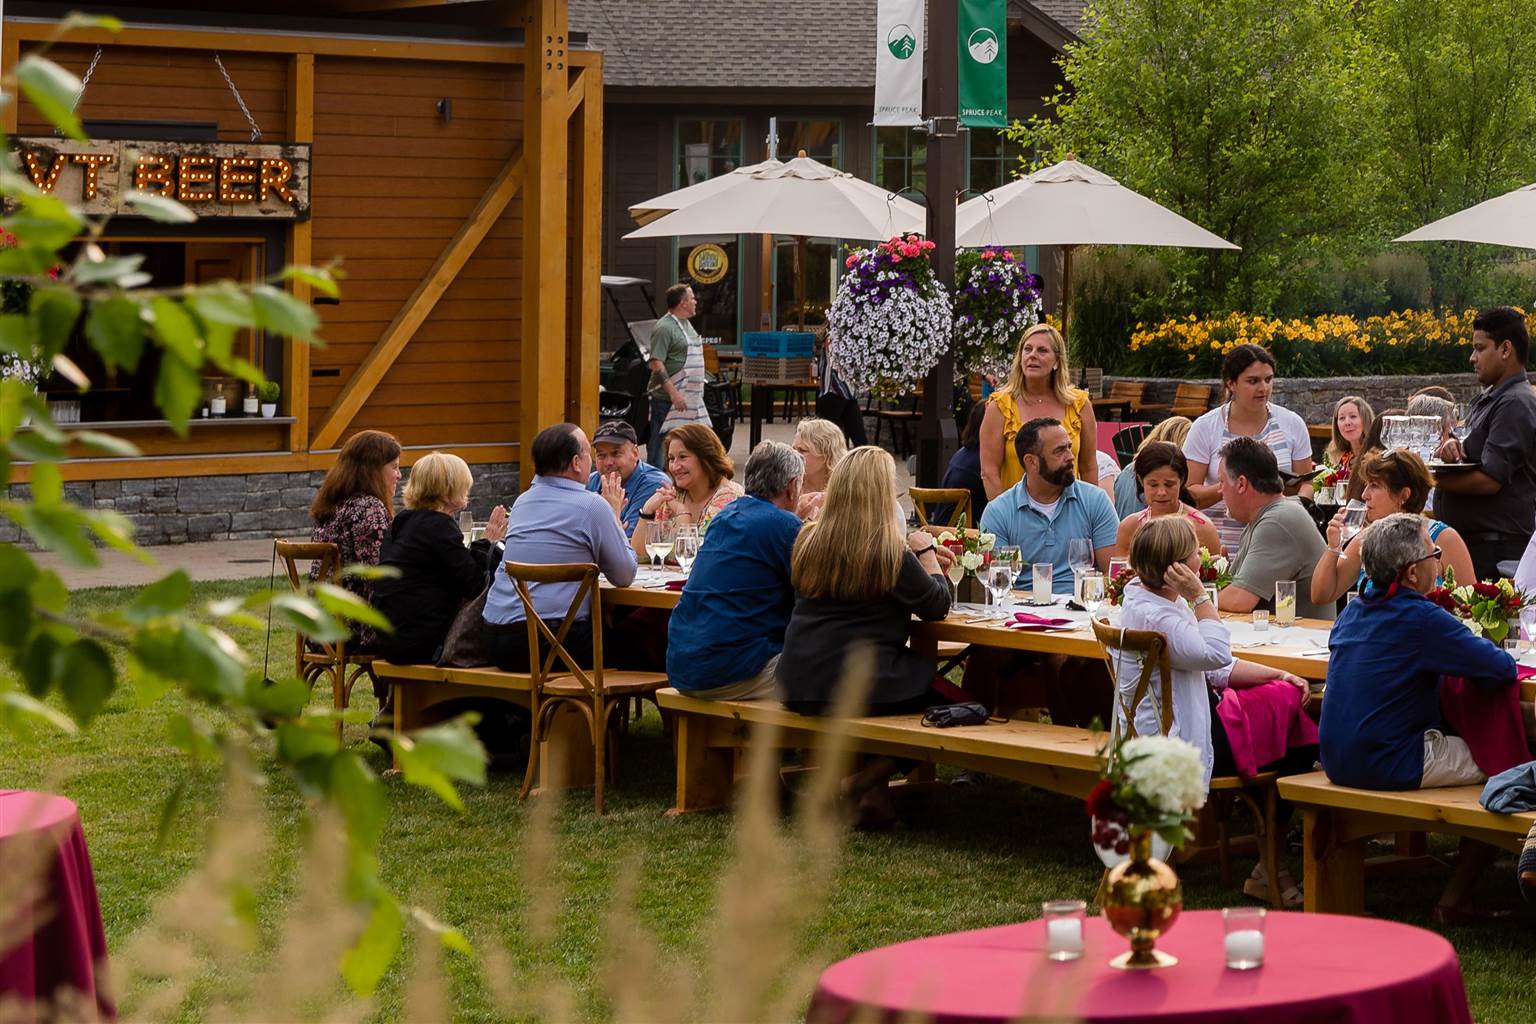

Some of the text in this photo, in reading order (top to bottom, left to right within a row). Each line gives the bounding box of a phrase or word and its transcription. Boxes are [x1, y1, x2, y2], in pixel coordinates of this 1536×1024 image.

[879, 105, 918, 114] SPRUCE PEAK
[962, 108, 1003, 117] SPRUCE PEAK
[20, 149, 297, 203] VT BEER
